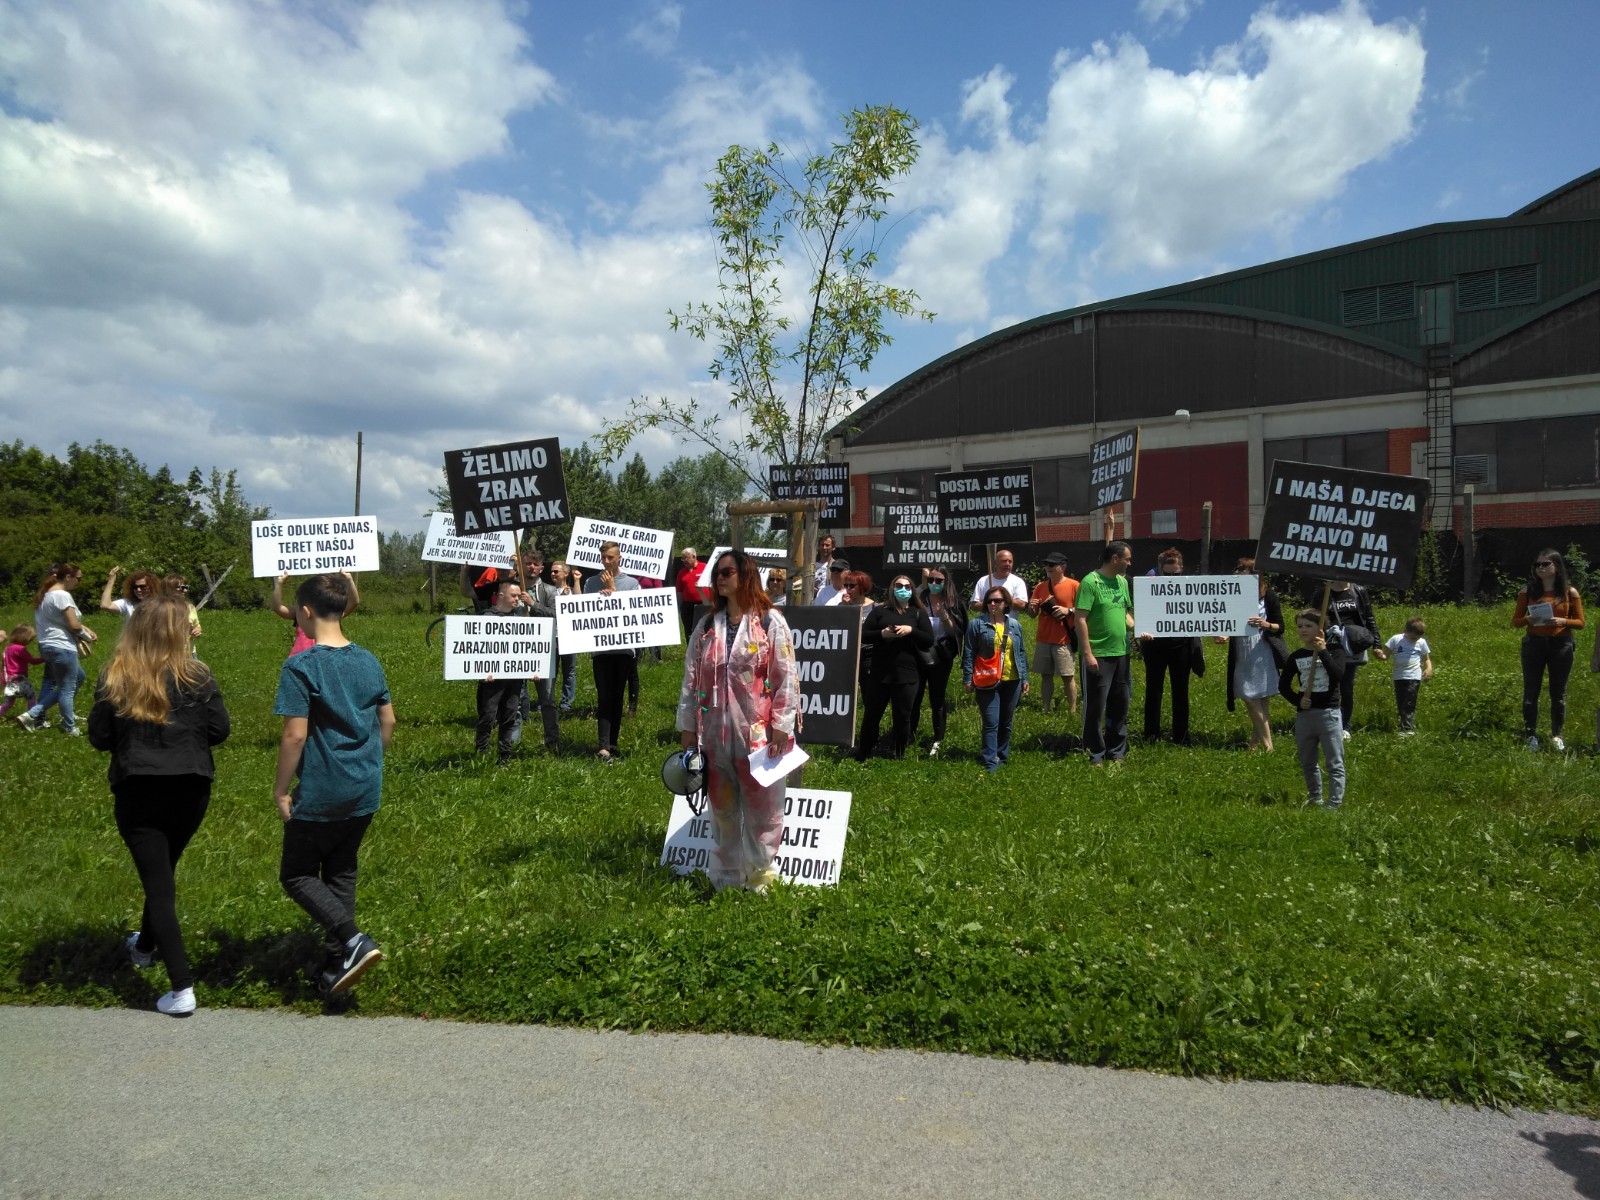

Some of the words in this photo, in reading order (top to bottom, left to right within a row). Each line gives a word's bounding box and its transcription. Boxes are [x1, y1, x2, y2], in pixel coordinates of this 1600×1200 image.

[1092, 434, 1134, 464] ŽELIMO
[461, 447, 548, 478] ŽELIMO
[1091, 456, 1132, 486] ZELENU
[478, 475, 541, 502] ZRAK
[821, 484, 843, 495] NAM
[940, 478, 980, 494] DOSTA
[984, 477, 1000, 490] JE
[1003, 474, 1029, 489] OVE
[1097, 478, 1124, 506] SMŽ
[950, 494, 1020, 512] PODMUKLE
[1275, 477, 1284, 495] I
[1289, 480, 1344, 503] NAŠA
[1351, 488, 1416, 512] DJECA
[464, 510, 479, 530] A
[484, 506, 513, 528] NE
[519, 500, 564, 523] RAK
[889, 505, 922, 516] DOSTA
[898, 514, 939, 524] JEDNAK
[1309, 504, 1376, 528] IMAJU
[256, 524, 283, 538] LOŠE
[288, 524, 330, 536] ODLUKE
[334, 522, 373, 534] DANAS,
[945, 514, 1028, 530] PREDSTAVE!!
[589, 523, 617, 536] SISAK
[618, 528, 630, 539] JE
[632, 530, 657, 543] GRAD
[1286, 522, 1354, 547] PRAVO
[1360, 532, 1388, 552] NA
[278, 541, 312, 554] TERET
[316, 537, 354, 552] NAŠOJ
[437, 538, 446, 546] NE
[448, 539, 474, 550] OTPADU
[619, 542, 664, 559] DAHNIMO
[278, 558, 311, 571] DJECI
[316, 556, 356, 568] SUTRA!
[427, 548, 440, 556] JER
[441, 550, 456, 558] SAM
[458, 551, 475, 561] SVOJ
[477, 554, 486, 562] NA
[887, 554, 895, 564] A
[900, 554, 914, 563] NE
[918, 552, 967, 563] NOVAC!!
[1270, 542, 1397, 575] ZDRAVLJE!!!
[619, 556, 660, 575] UĆIMA(?)
[1150, 581, 1182, 596] NAŠA
[1186, 580, 1242, 596] DVORIŠTA
[560, 597, 626, 614] POLITIČARI,
[630, 594, 673, 608] NEMATE
[1166, 602, 1194, 614] NISU
[1198, 598, 1226, 614] VAŠA
[464, 622, 482, 635] NE!
[485, 622, 534, 636] OPASNOM
[538, 624, 541, 636] I
[572, 616, 619, 632] MANDAT
[623, 614, 638, 627] DA
[642, 612, 664, 625] NAS
[1156, 617, 1236, 632] ODLAGALIŠTA!
[453, 642, 510, 654] ZARAZNOM
[512, 642, 550, 654] OTPADU
[594, 632, 646, 647] TRUJETE!
[792, 628, 848, 650] OGATI
[464, 662, 470, 674] U
[474, 660, 500, 674] MOM
[504, 660, 540, 674] GRADU!
[795, 661, 825, 682] MO
[800, 694, 850, 716] DAJU
[798, 798, 832, 819] TLO!
